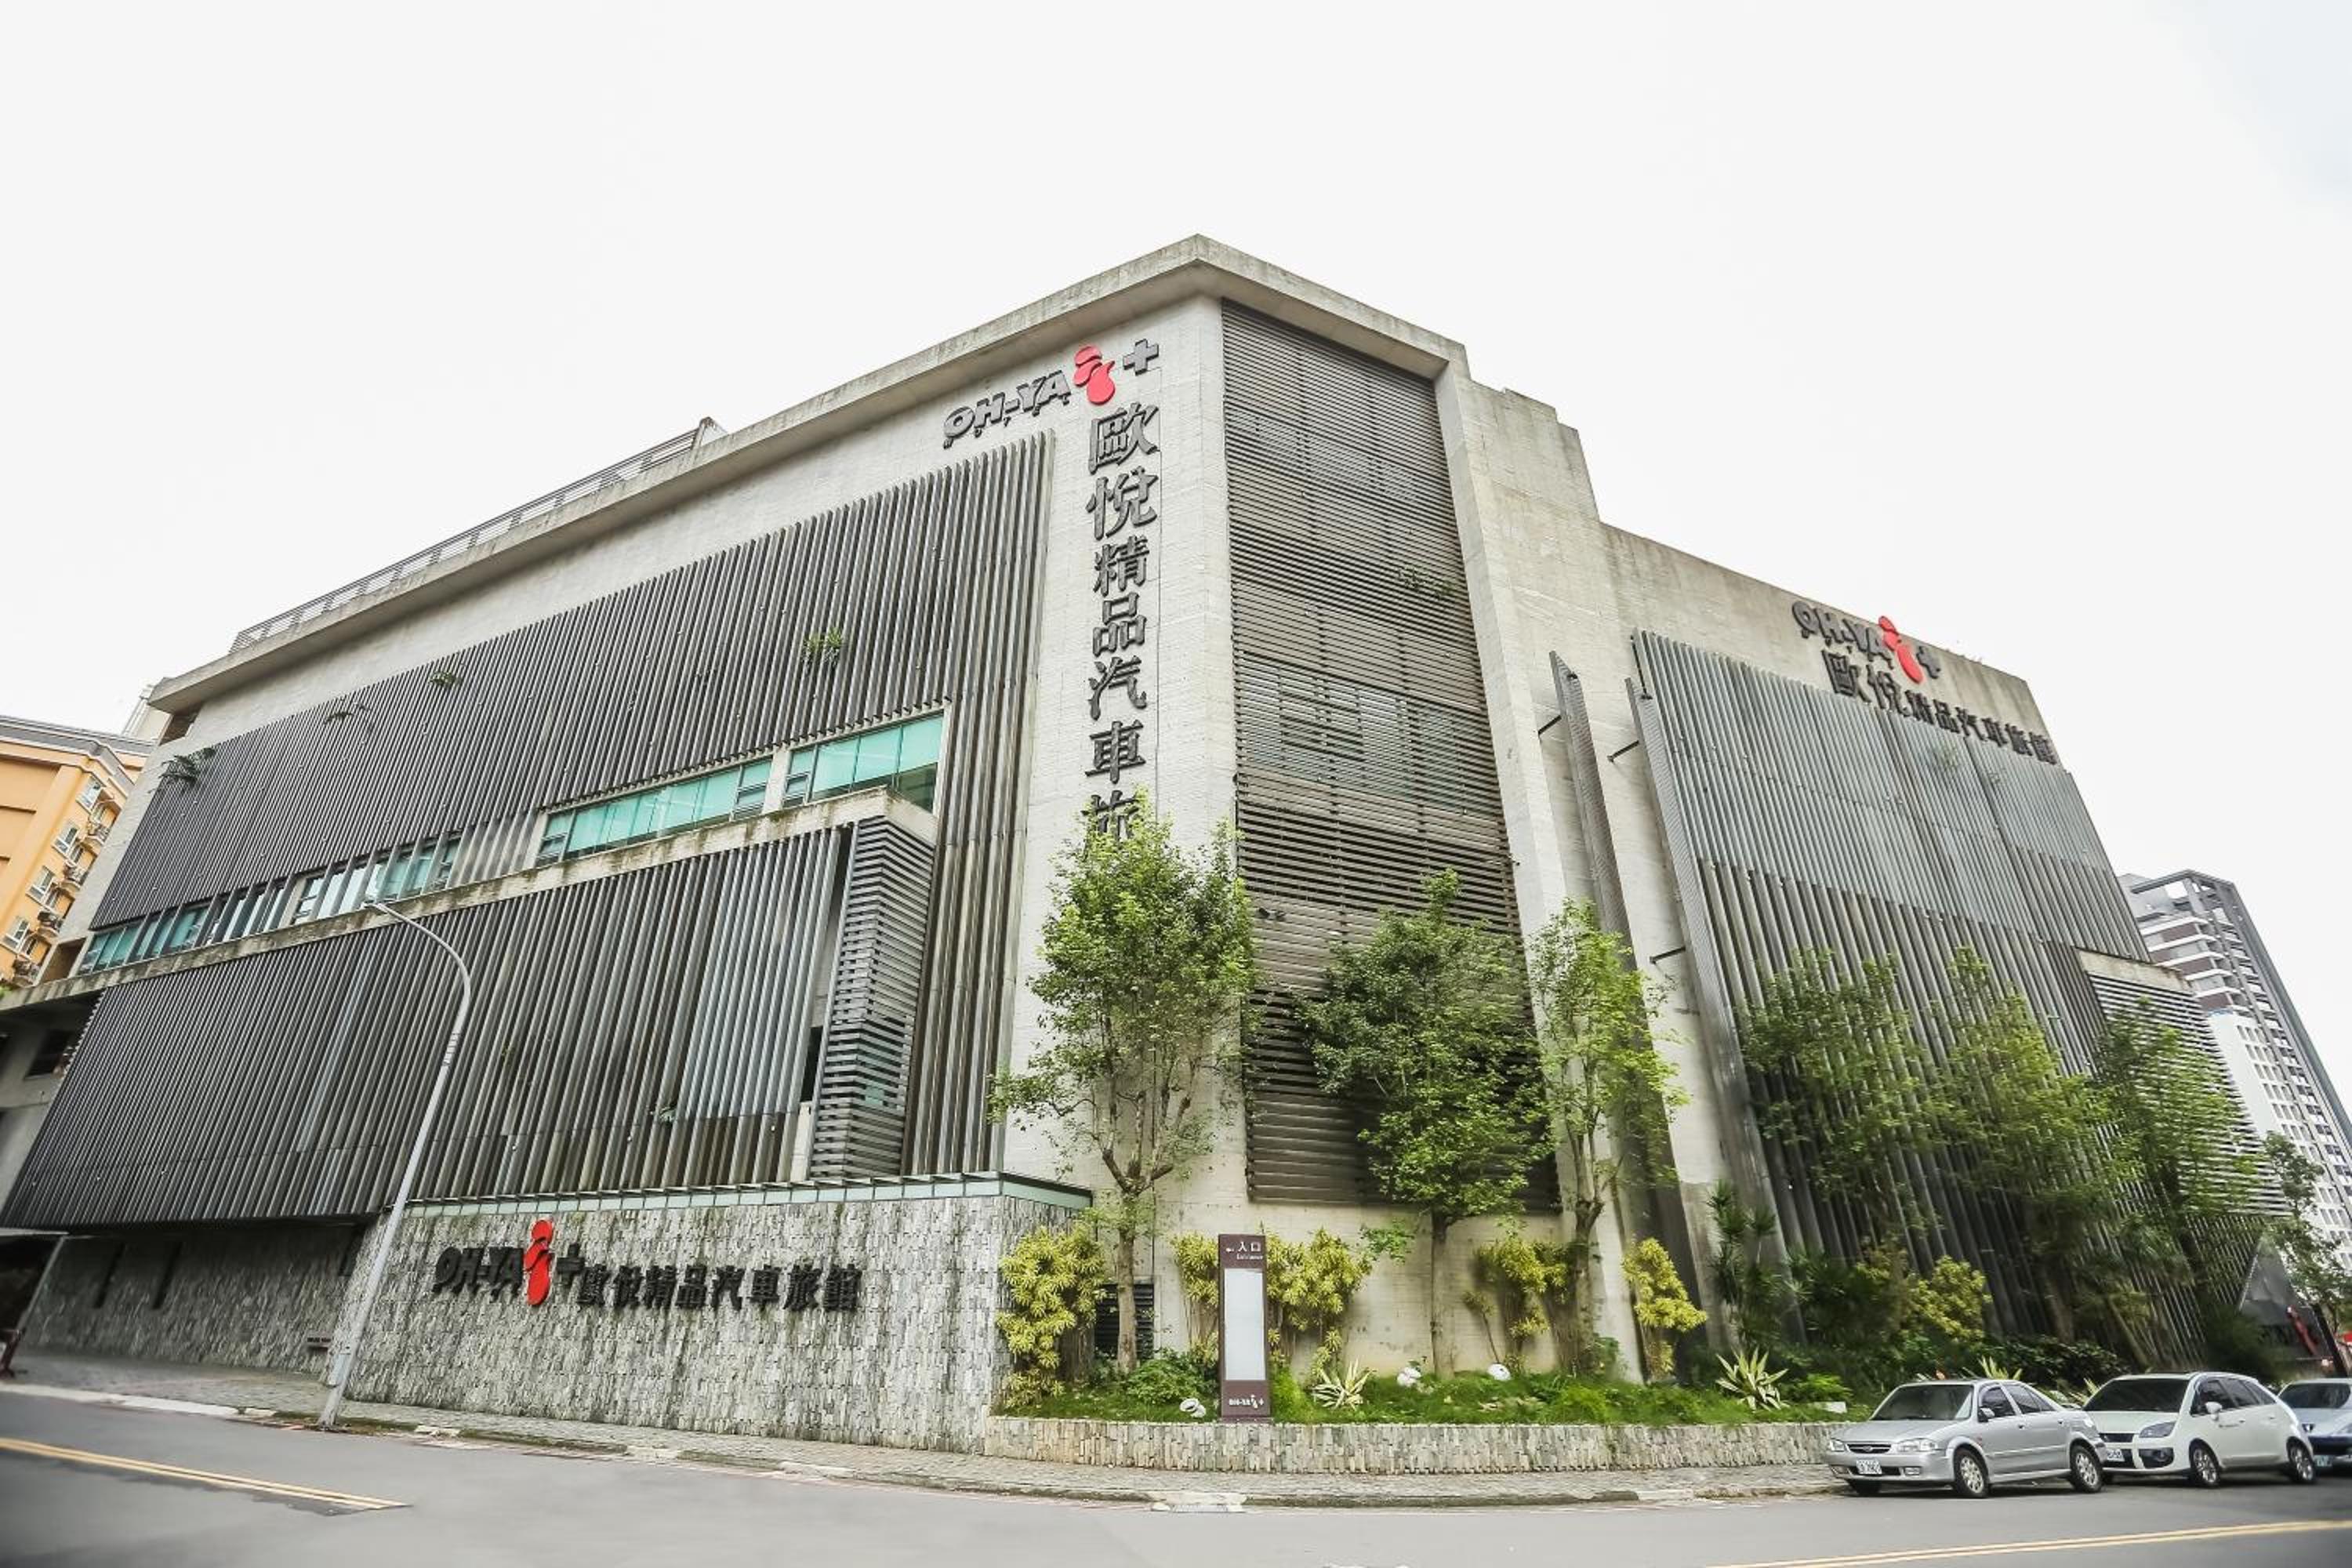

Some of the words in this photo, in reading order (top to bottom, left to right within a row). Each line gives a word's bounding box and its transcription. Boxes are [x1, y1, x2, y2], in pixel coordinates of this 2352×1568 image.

[943, 369, 1071, 442] OH-YA
[434, 1246, 524, 1294] OH-YA
[1237, 1241, 1261, 1252] 入口
